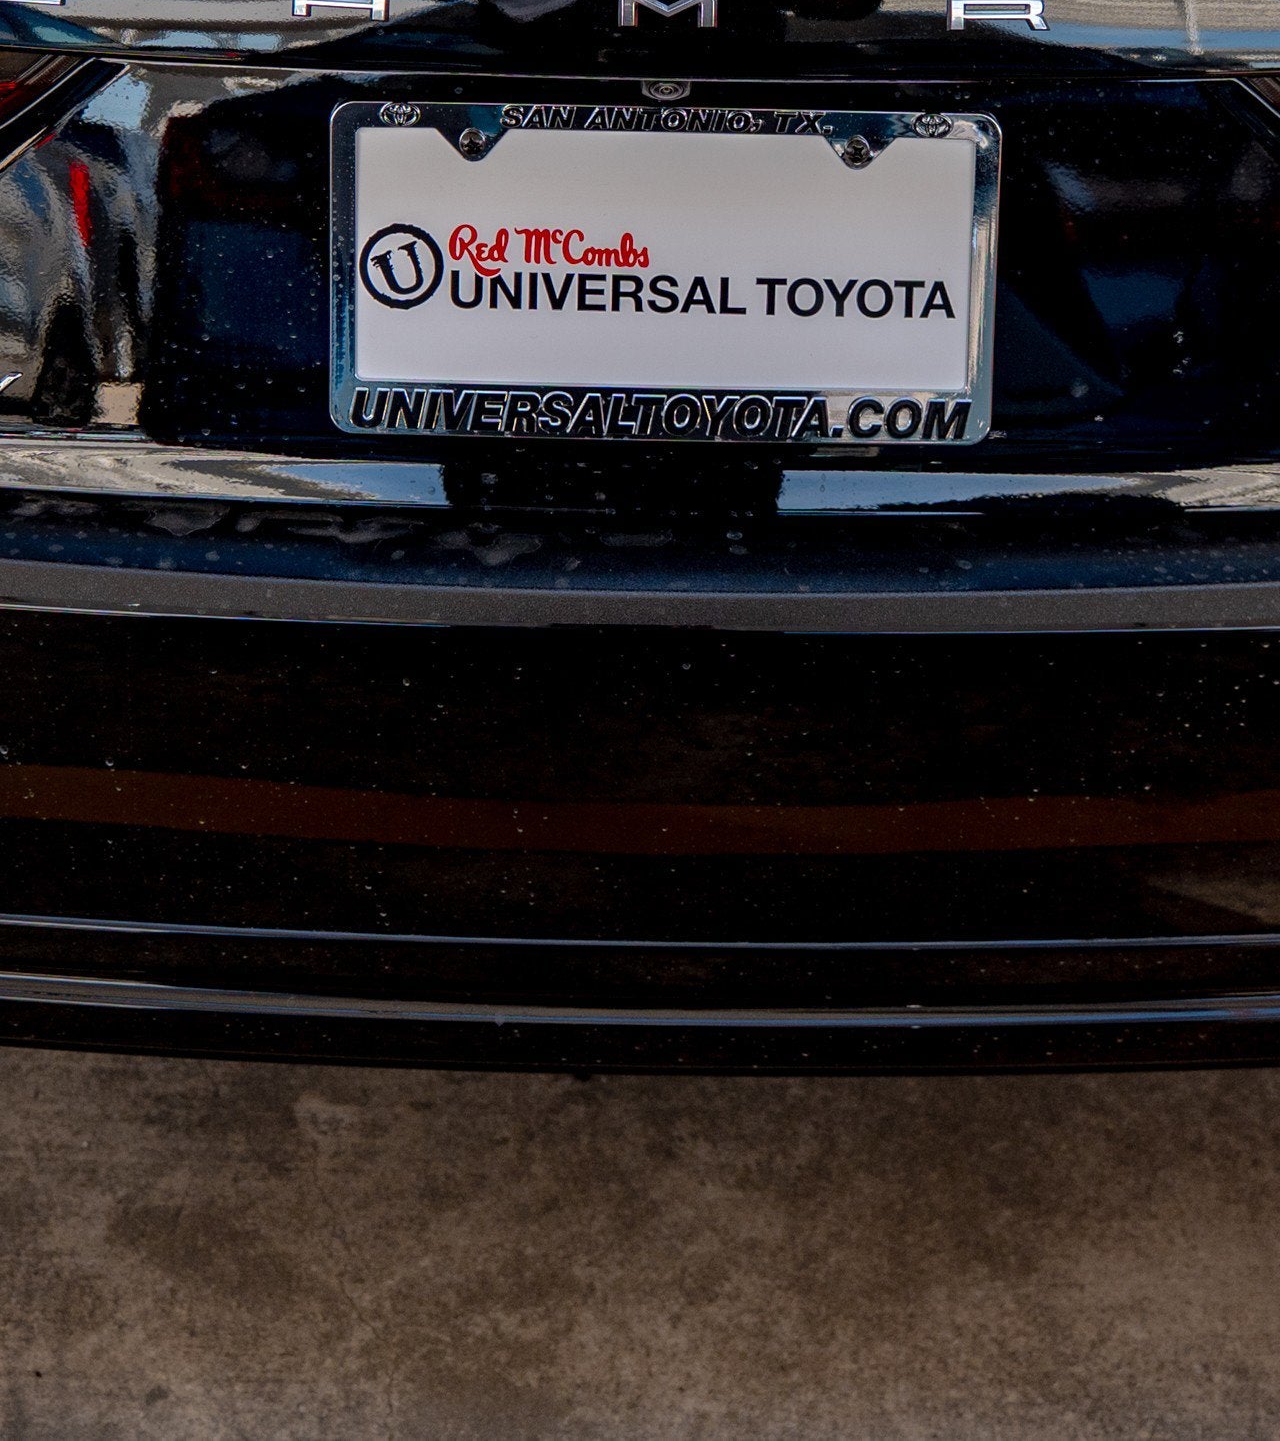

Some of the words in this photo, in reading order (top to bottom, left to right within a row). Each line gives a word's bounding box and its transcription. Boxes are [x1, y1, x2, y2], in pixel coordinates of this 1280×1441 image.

[499, 104, 577, 129] SAN
[584, 107, 766, 134] ANTONIO,
[448, 224, 509, 277] Red
[514, 227, 650, 268] McCombs
[449, 269, 747, 315] UNIVERSAL
[755, 277, 956, 319] TOYOTA
[349, 387, 973, 440] UNIVERSALTOYOTA.COM
